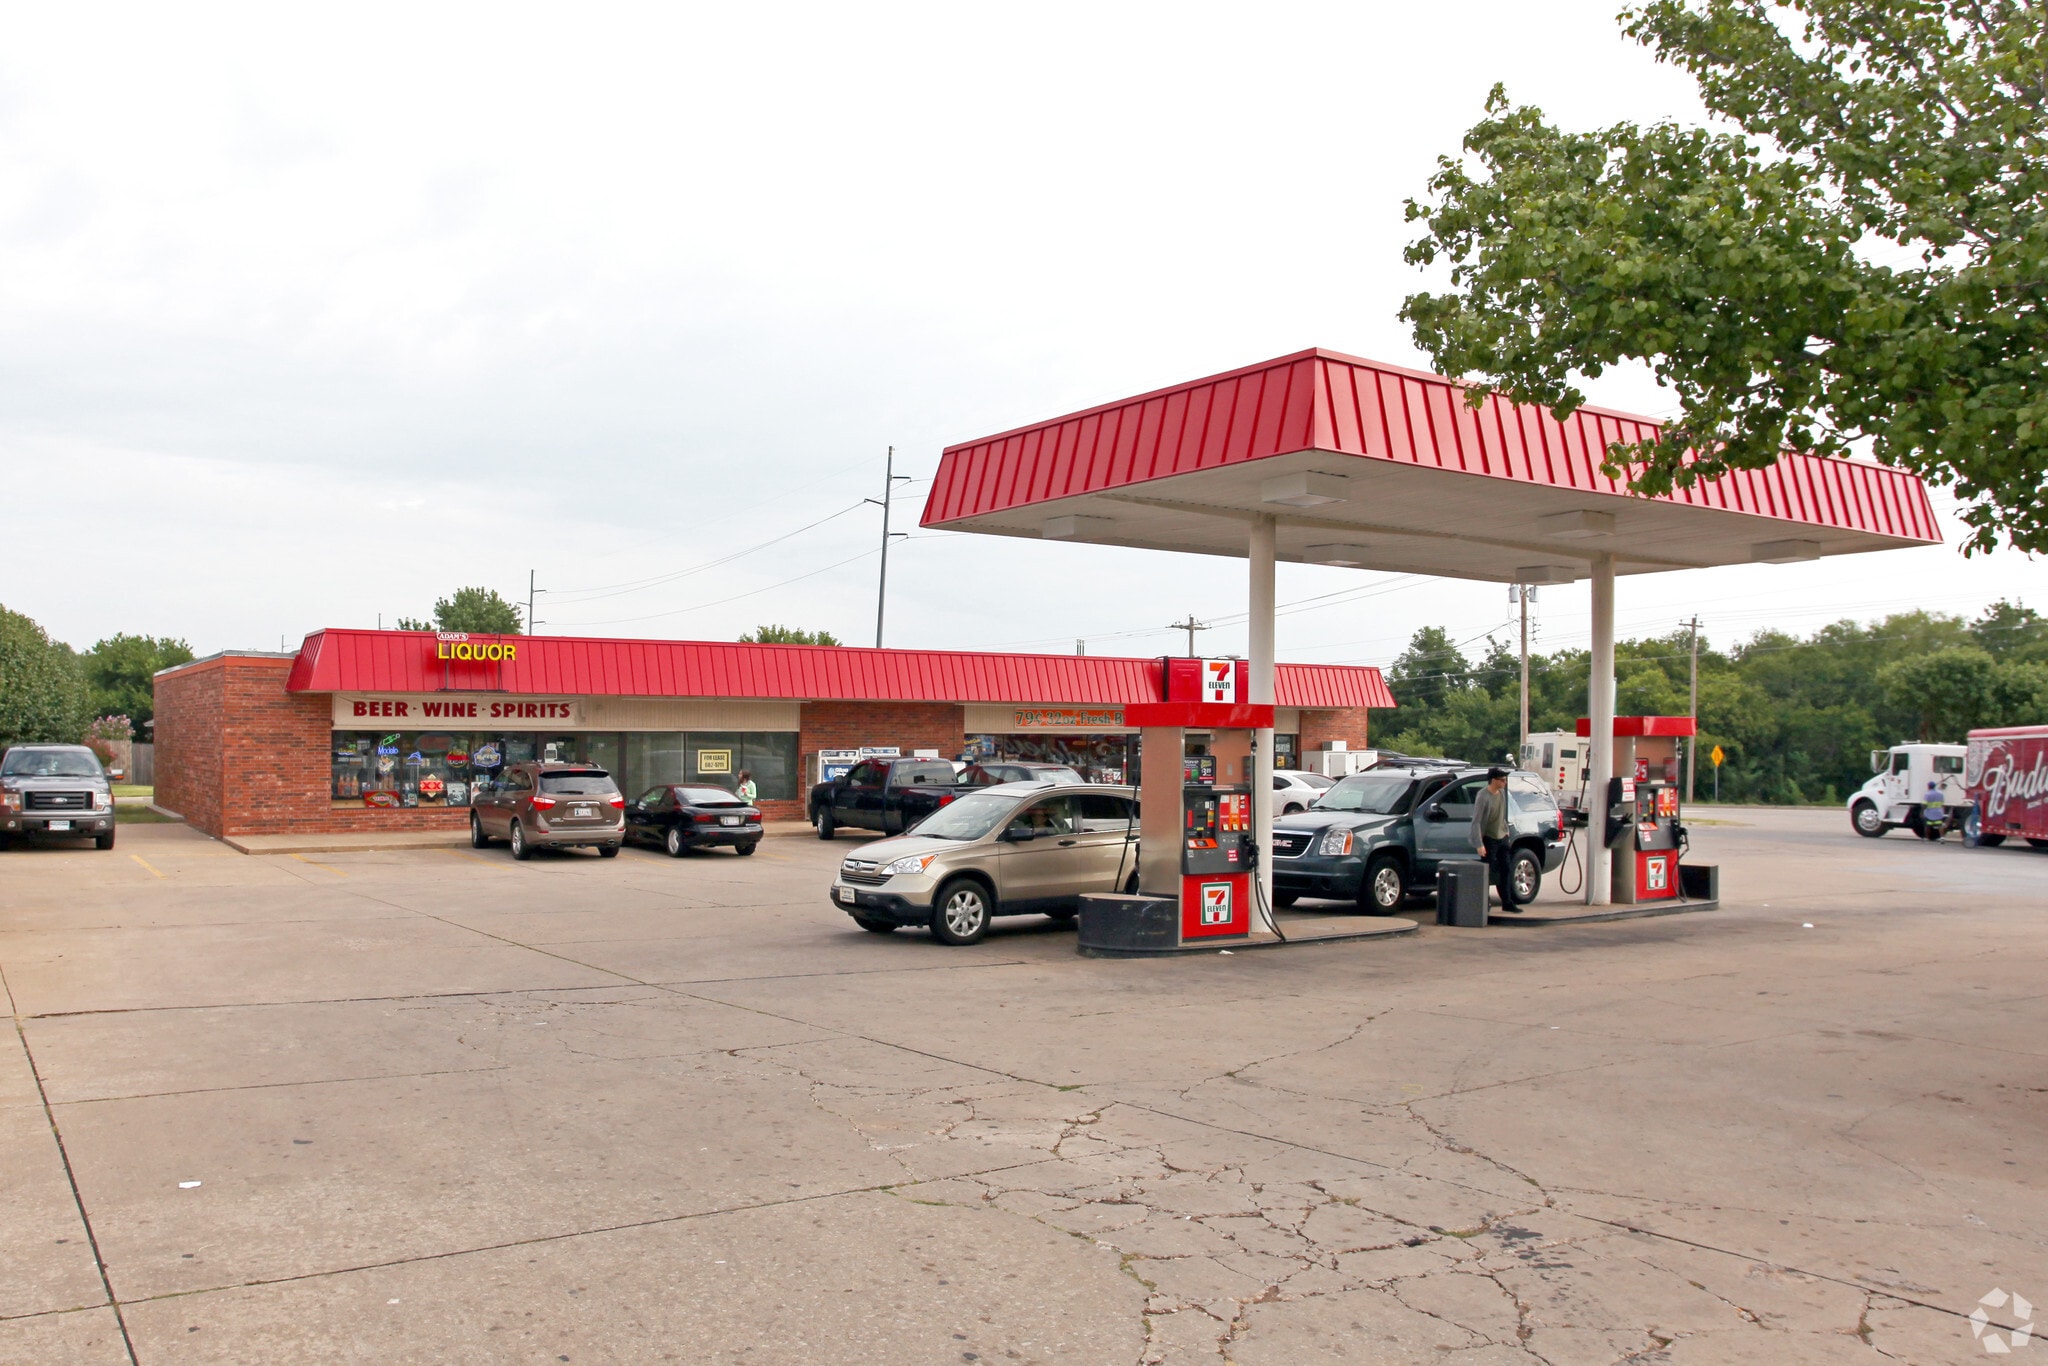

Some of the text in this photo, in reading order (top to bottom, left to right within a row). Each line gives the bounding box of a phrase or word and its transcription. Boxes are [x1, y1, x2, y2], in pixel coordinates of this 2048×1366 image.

[438, 643, 517, 661] LIQUOR
[353, 701, 570, 718] BEER WINE SPIRITS
[1015, 711, 1126, 726] 79¢ 32oz Fresh B
[377, 746, 399, 755] Modelo
